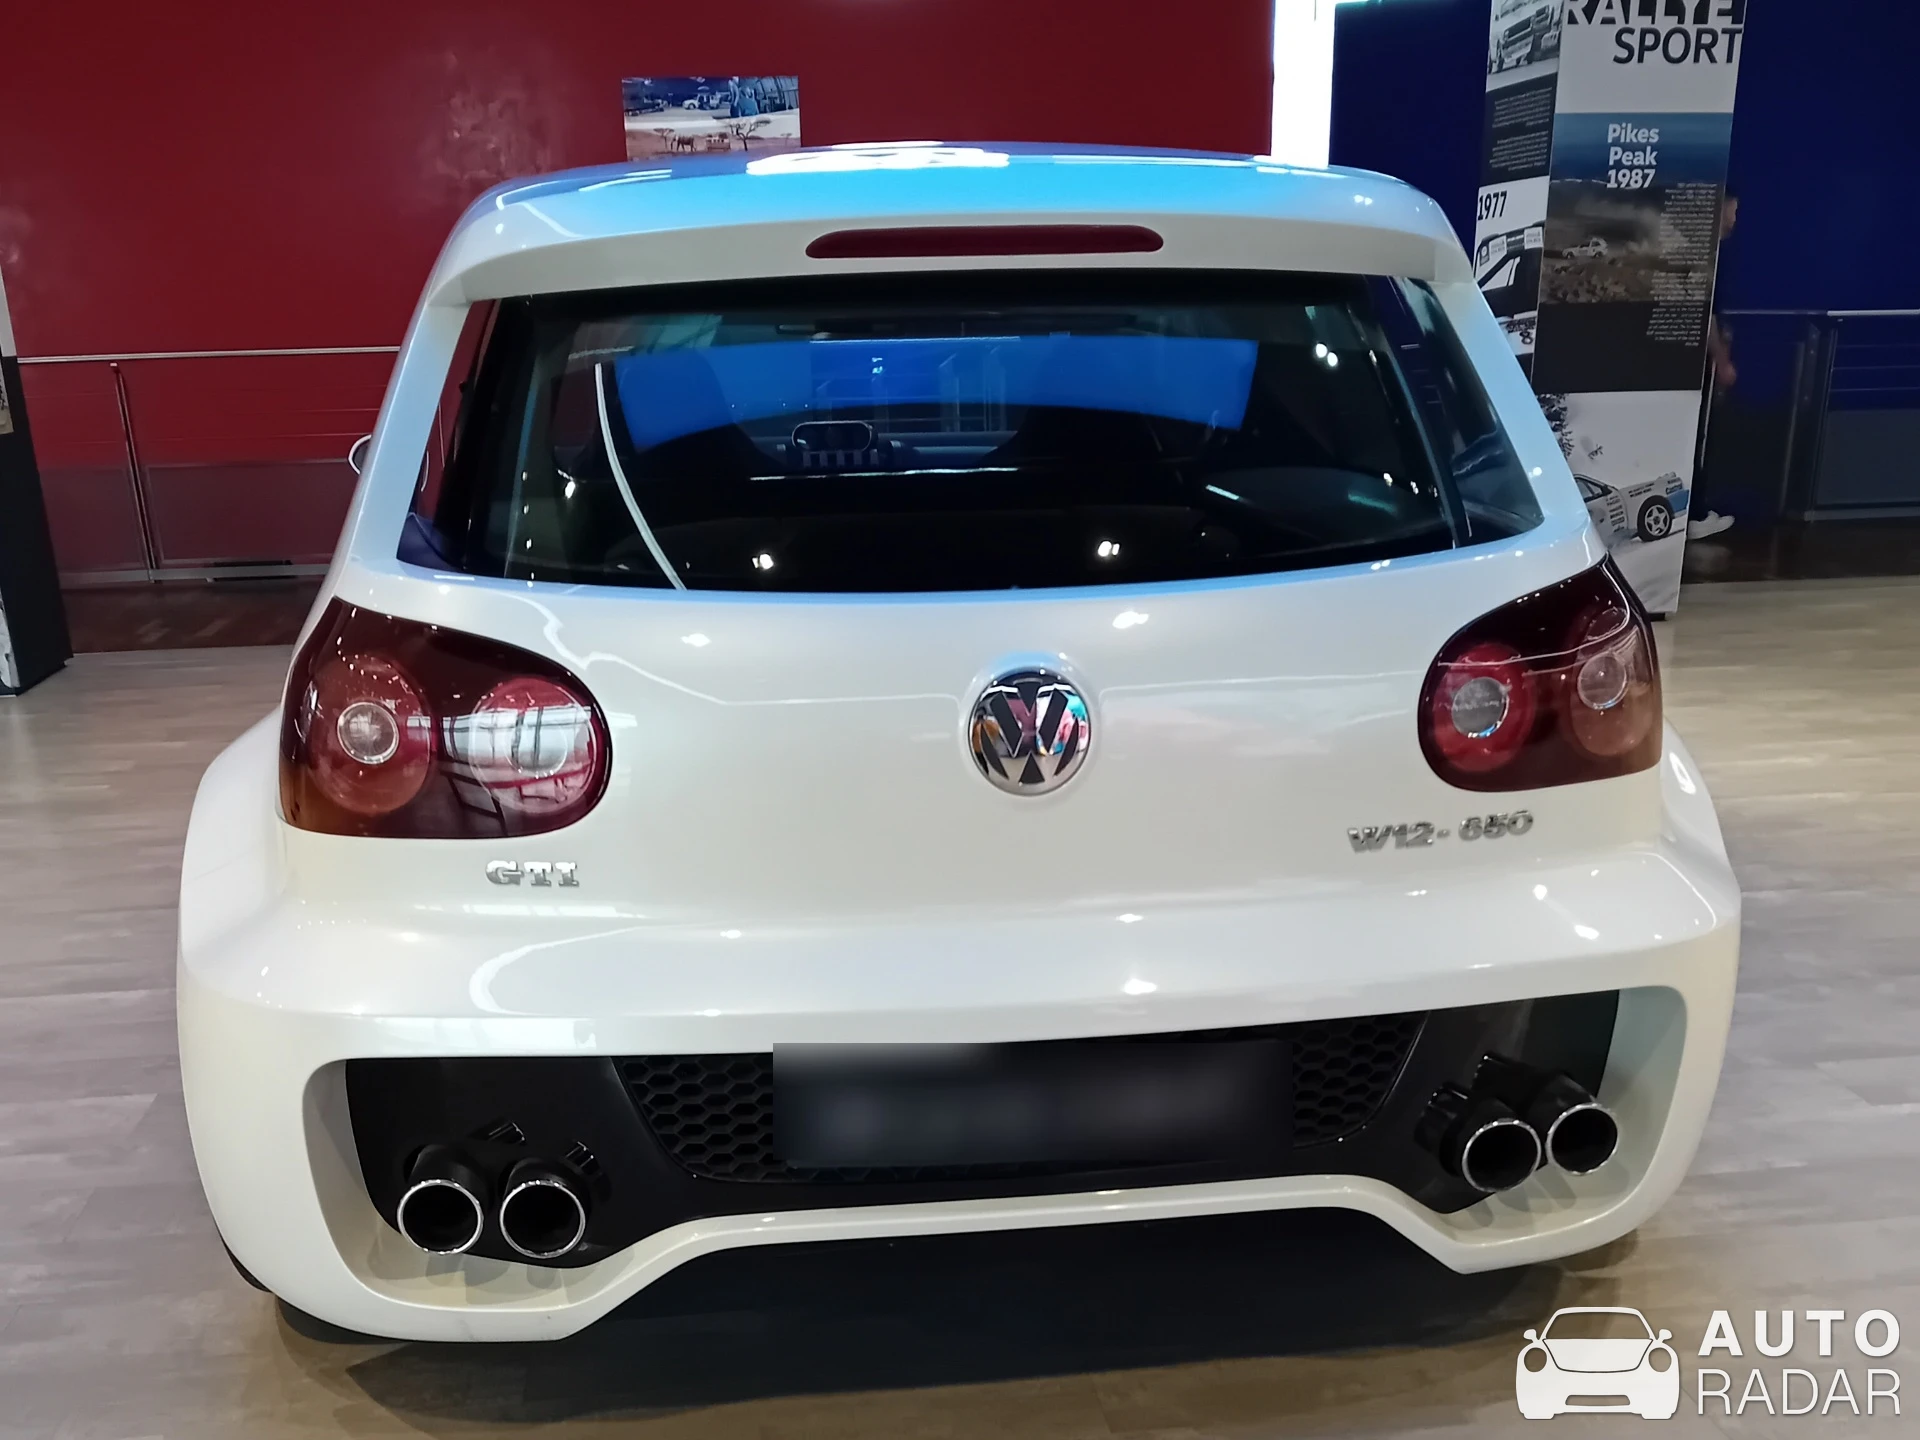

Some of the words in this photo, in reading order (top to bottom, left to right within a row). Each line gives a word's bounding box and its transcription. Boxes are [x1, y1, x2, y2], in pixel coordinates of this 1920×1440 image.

[1563, 0, 1735, 25] RALLYE
[1612, 26, 1743, 64] SPORT
[1607, 122, 1660, 143] Pikes
[1608, 145, 1658, 166] Peak
[1606, 168, 1656, 189] 1987
[1477, 190, 1508, 221] 1977
[968, 667, 1091, 796] VW
[486, 860, 580, 887] GTI
